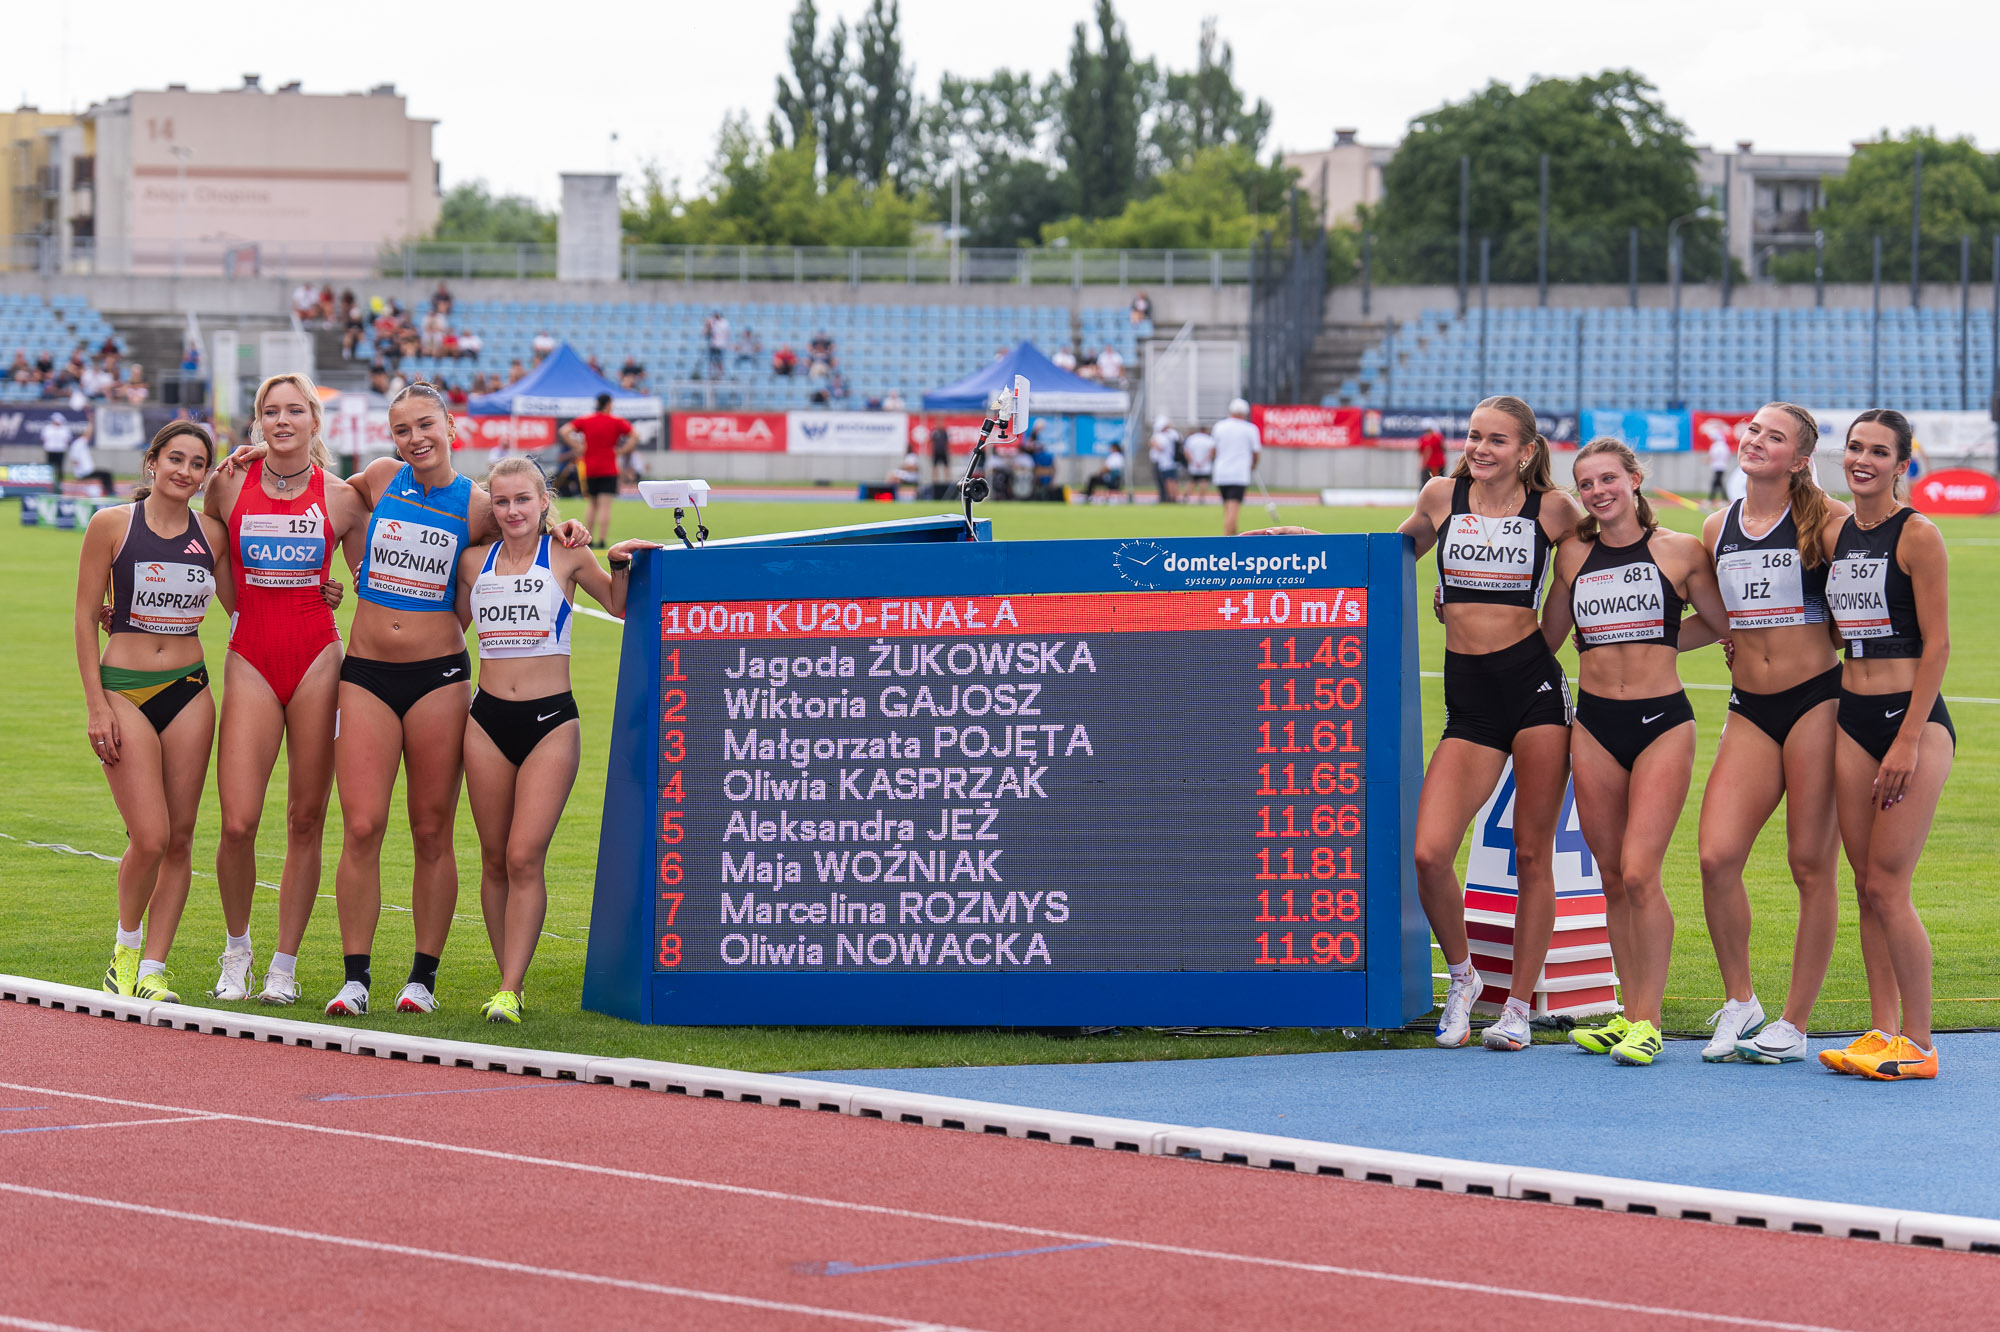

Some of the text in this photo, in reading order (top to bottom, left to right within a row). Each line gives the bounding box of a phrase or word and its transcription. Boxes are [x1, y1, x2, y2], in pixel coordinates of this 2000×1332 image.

[147, 118, 174, 140] 14
[686, 417, 773, 442] PZLA
[289, 520, 316, 534] 157
[1502, 521, 1522, 535] 56
[382, 533, 402, 541] ORLEN
[419, 529, 449, 547] 105
[247, 544, 317, 562] GAJOSZ
[373, 546, 449, 575] WOŹNIAK
[1163, 551, 1327, 574] domtel-sport.pl
[1449, 544, 1528, 564] ROZMYS
[1762, 553, 1792, 568] 168
[186, 568, 205, 583] 53
[252, 577, 294, 585] WŁOCŁAWEK
[1623, 566, 1653, 583] 681
[1851, 564, 1879, 579] 567
[374, 581, 436, 598] WŁOCŁAWEK 2025
[514, 579, 544, 593] 159
[1185, 576, 1227, 587] systemy
[1230, 576, 1273, 586] pomiaru
[1453, 578, 1500, 588] WŁOCŁAWEK
[1742, 577, 1771, 600] JEŻ
[135, 590, 209, 609] KASPRZAK
[1577, 593, 1661, 618] NOWACKA
[479, 605, 540, 624] POJĘTA
[666, 605, 755, 634] 100m
[766, 604, 789, 632] K
[1218, 591, 1290, 624] +1.0
[1301, 590, 1361, 623] m/s
[1775, 616, 1795, 624] 2025
[138, 621, 184, 632] WŁOCŁAWEK
[1589, 629, 1654, 641] WŁOCŁAWEK 2025
[664, 635, 1362, 687] 1 Jagoda ŻUKOWSKA 11.46
[663, 677, 1362, 722] 2 Wiktoria GAJOSZ 11.50
[663, 720, 1361, 768] 3 Małgorzata POJĘTA 11.61
[662, 762, 1360, 803] 4 Oliwia KASPRZAK 11.65
[661, 801, 1361, 844] 5 Aleksandra JEŻ 11.66
[660, 843, 1360, 892] 6 Maja WOŹNIAK 11.81
[661, 889, 1360, 926] 7 Marcelina ROZMYS 11.88
[658, 931, 1360, 967] 8 Oliwia NOWACKA 11.90
